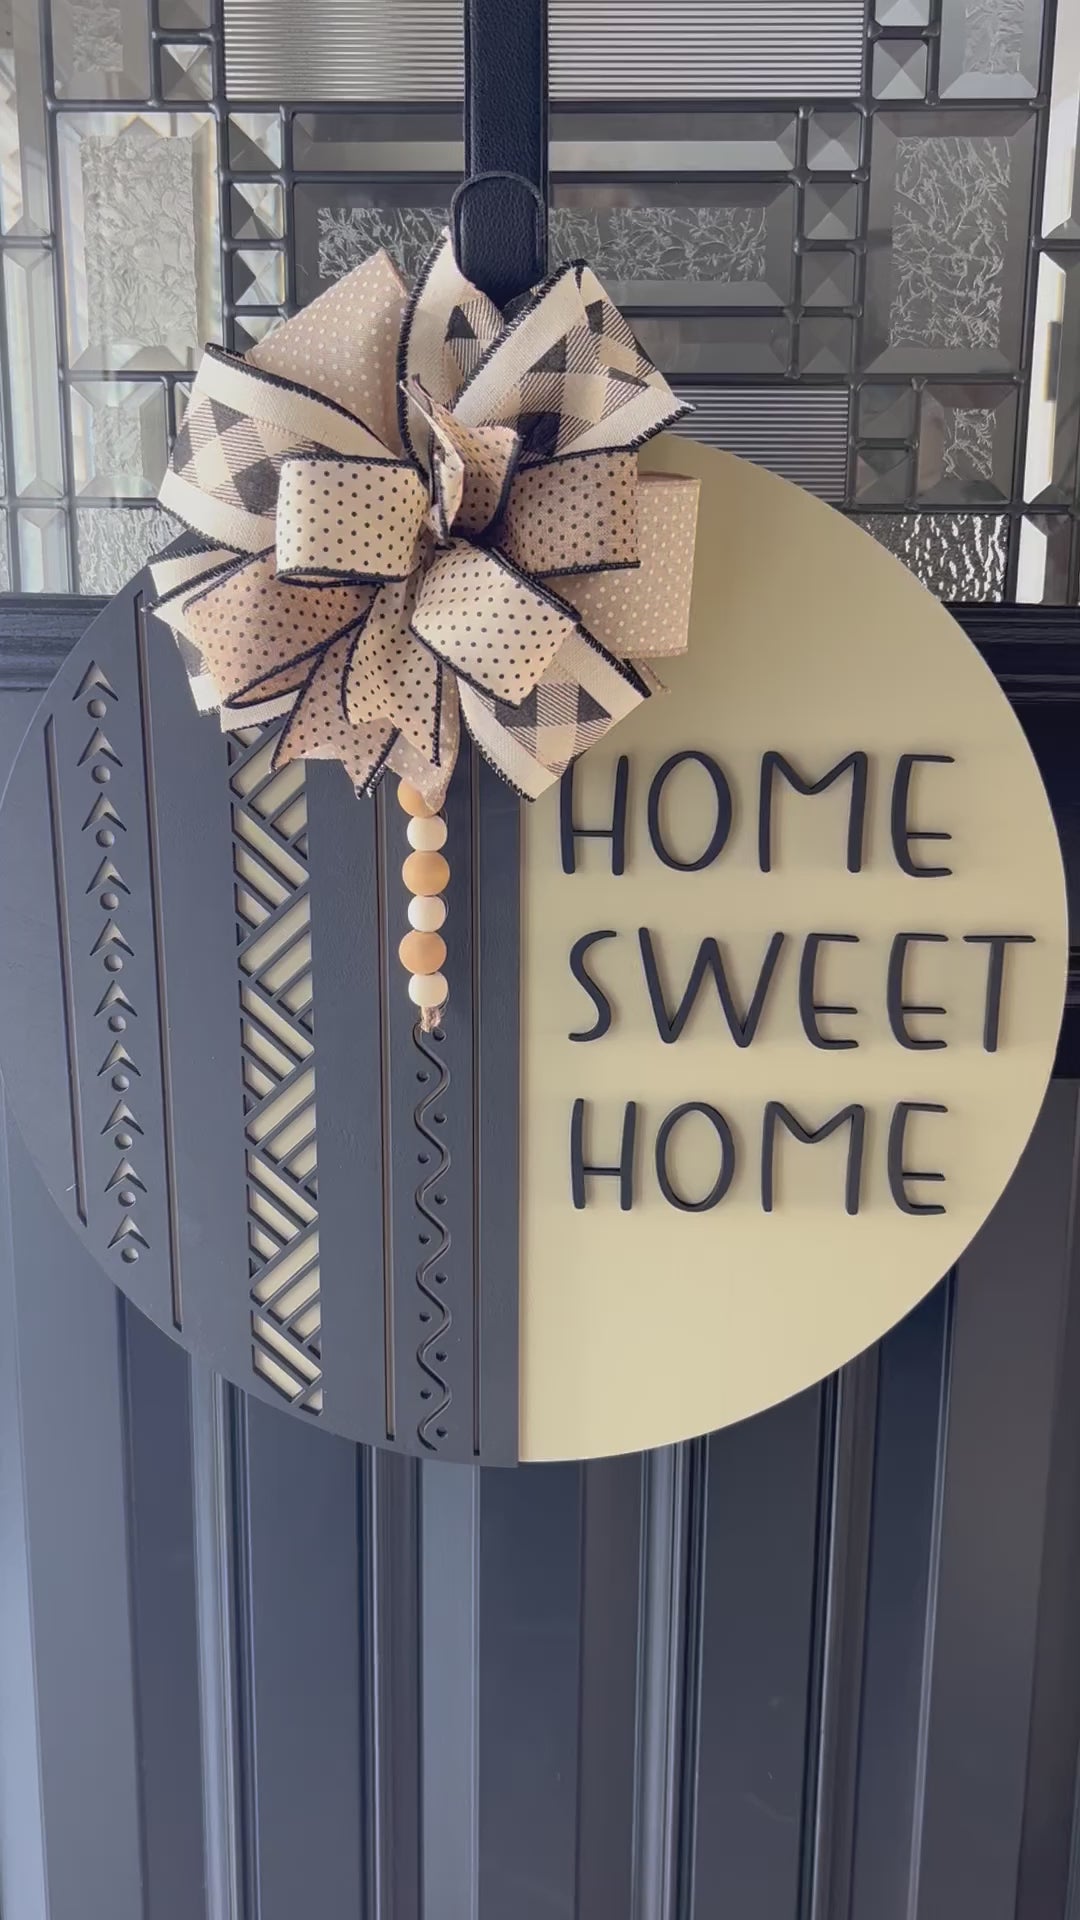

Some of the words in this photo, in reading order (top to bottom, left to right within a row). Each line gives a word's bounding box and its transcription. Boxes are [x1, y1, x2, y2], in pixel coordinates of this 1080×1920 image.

[560, 750, 955, 877] HOME
[568, 927, 1036, 1052] SWEET
[570, 1098, 948, 1215] HOME
